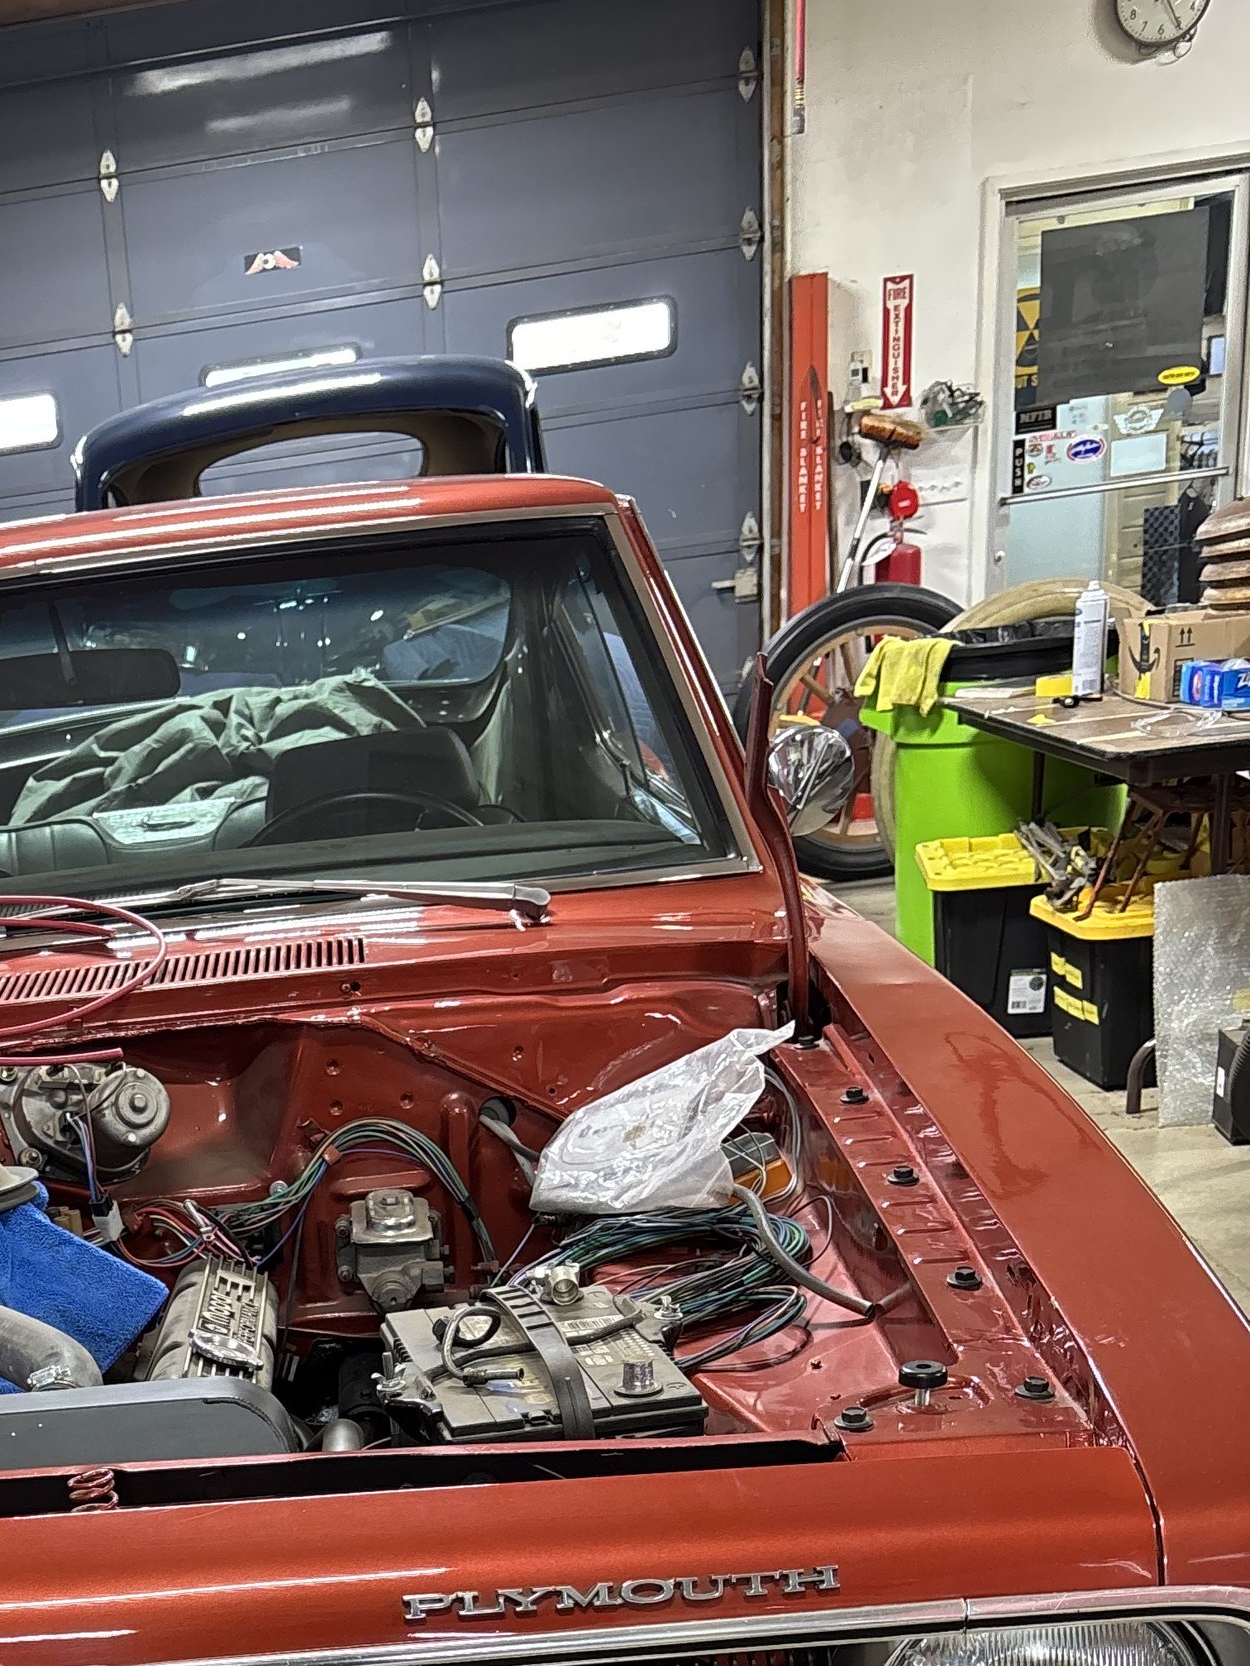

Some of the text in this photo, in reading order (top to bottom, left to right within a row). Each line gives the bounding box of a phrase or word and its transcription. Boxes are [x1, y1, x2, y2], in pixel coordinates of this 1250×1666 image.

[1130, 8, 1137, 20] 8
[1141, 20, 1148, 32] 7
[1157, 23, 1165, 35] 6
[888, 286, 907, 301] FIRE
[891, 304, 901, 397] EXTINGUISHER
[798, 401, 808, 513] FIRE BLANKET
[814, 445, 824, 511] BLANKET
[402, 1564, 841, 1621] PLYMOUTH
